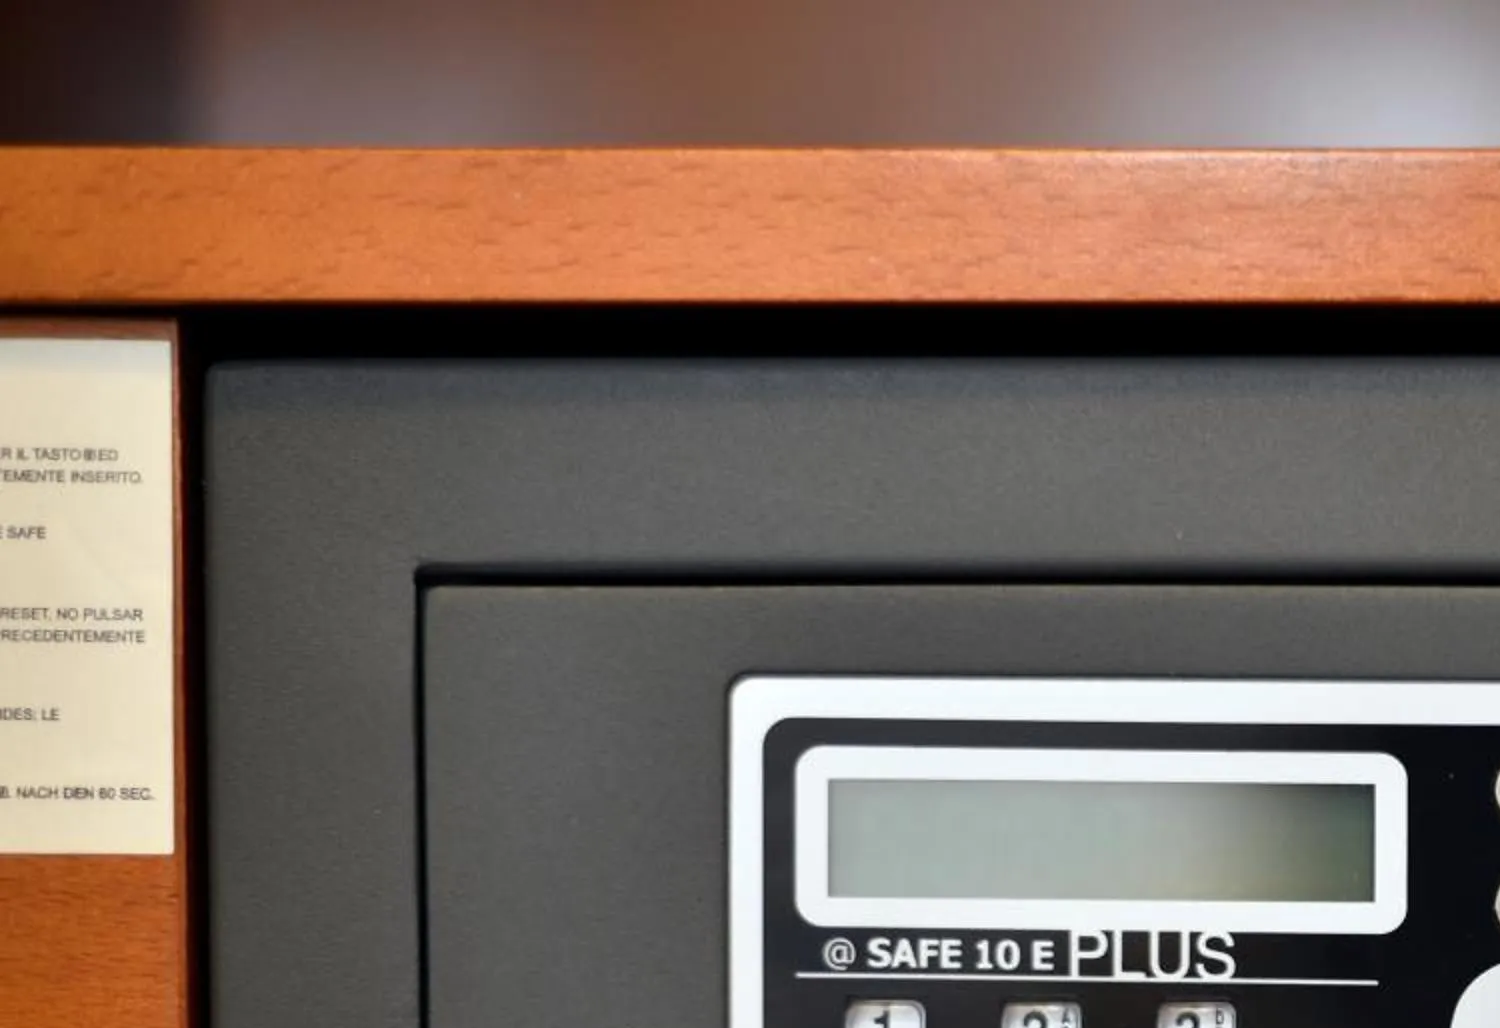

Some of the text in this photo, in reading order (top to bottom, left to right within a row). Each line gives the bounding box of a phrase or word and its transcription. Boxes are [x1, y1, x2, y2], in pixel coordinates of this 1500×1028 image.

[33, 447, 81, 461] TASTO
[0, 469, 66, 483] EMENTE
[6, 526, 47, 539] SAFE
[56, 607, 79, 621] NO
[83, 607, 143, 621] PULSAR
[0, 629, 146, 643] RECEDENTEMENTE
[41, 708, 60, 721] LE
[16, 786, 58, 799] NACH
[62, 787, 94, 800] DEN
[822, 930, 1237, 979] @ SAFE 10 E PLUS
